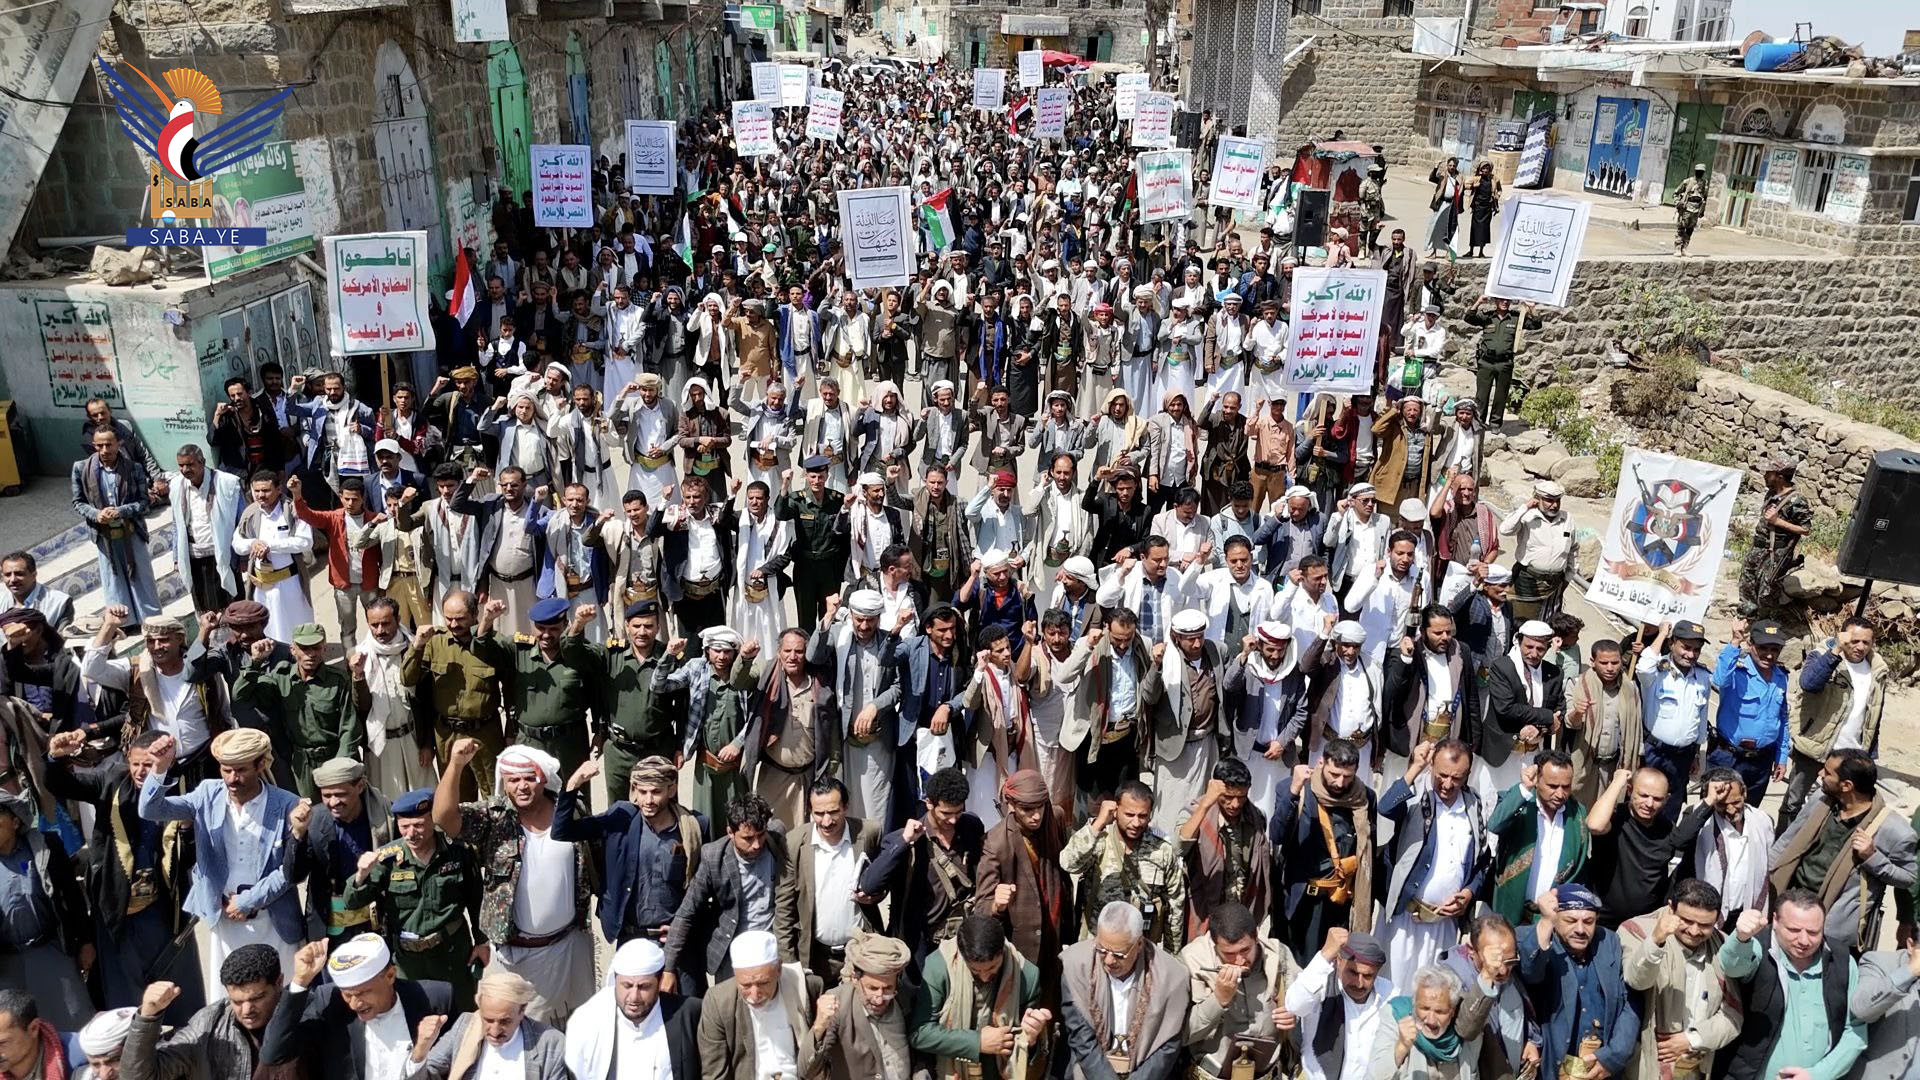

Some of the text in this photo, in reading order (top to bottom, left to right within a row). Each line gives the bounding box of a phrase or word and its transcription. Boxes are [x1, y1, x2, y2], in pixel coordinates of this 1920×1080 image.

[539, 152, 584, 169] الله أكبر
[542, 206, 587, 220] النصر للإسلام
[340, 246, 411, 272] قاطعوا
[382, 277, 411, 297] البضائع
[1302, 280, 1372, 306] الله أكبر
[377, 301, 382, 316] و
[1338, 309, 1369, 323] الموت
[43, 306, 108, 330] الله أكبر
[1336, 328, 1366, 341] الموت
[1296, 344, 1363, 360] اللعنة على اليهود
[1292, 362, 1361, 383] النصر للإسلام
